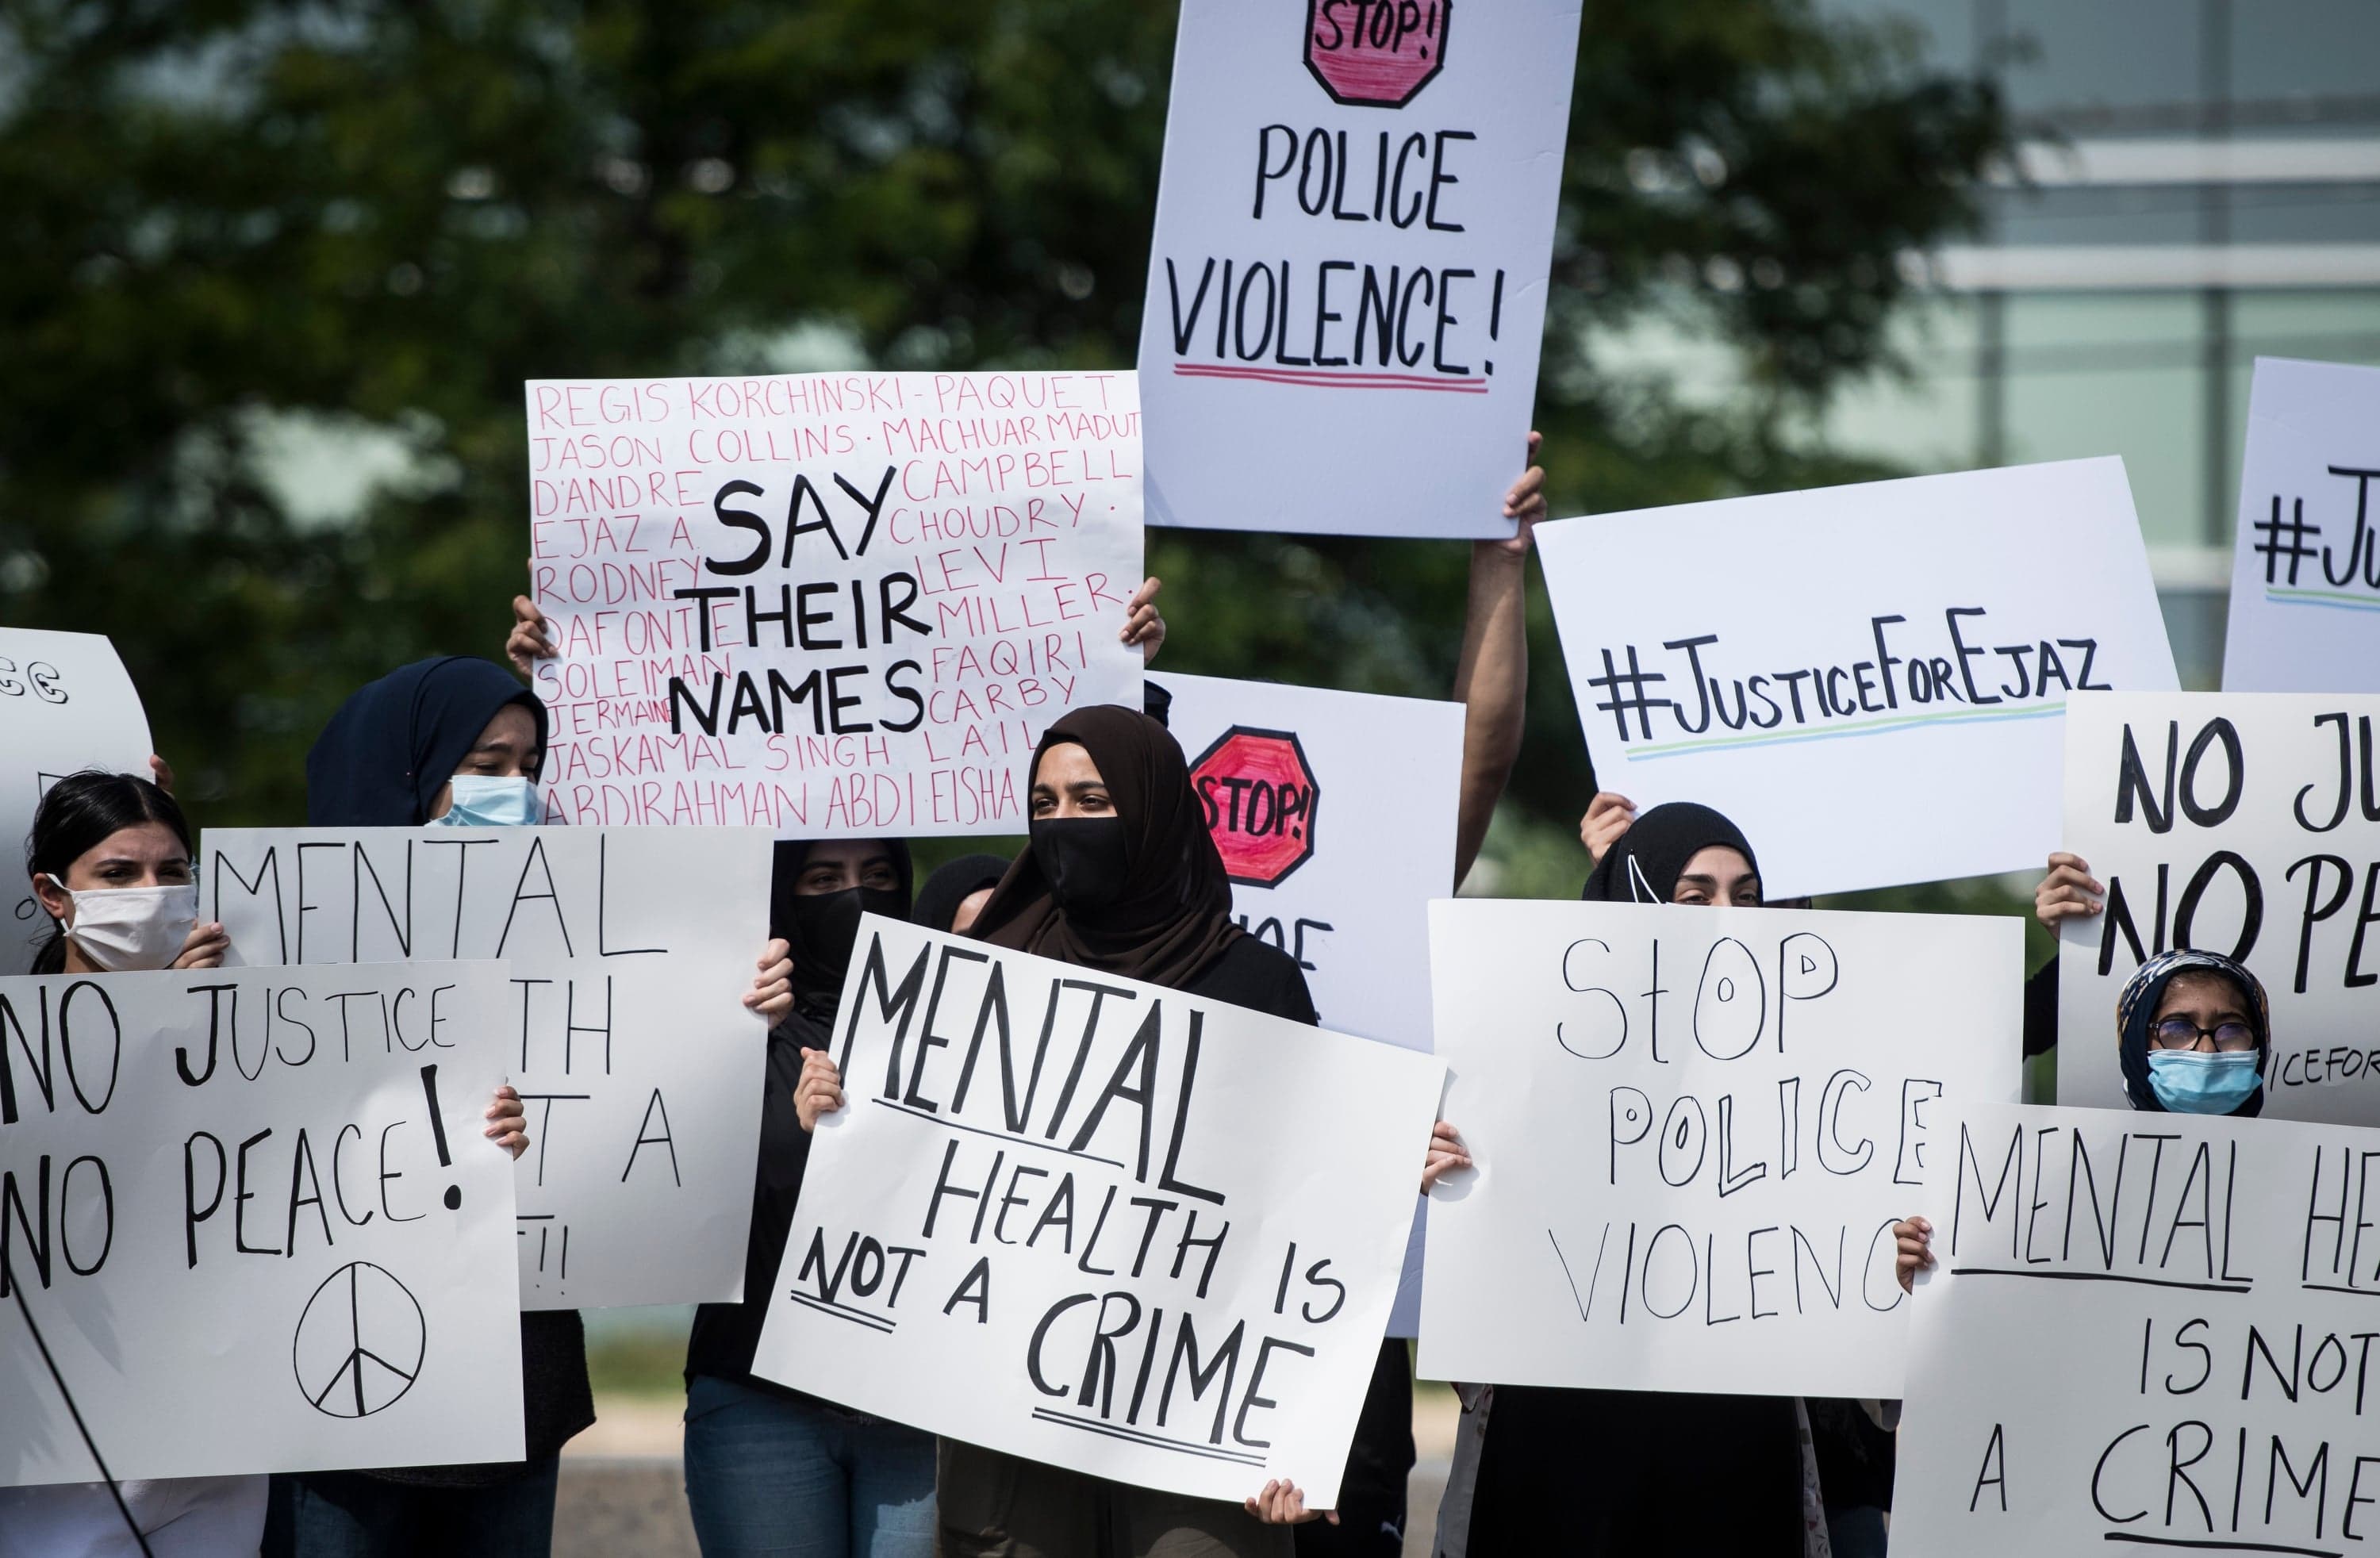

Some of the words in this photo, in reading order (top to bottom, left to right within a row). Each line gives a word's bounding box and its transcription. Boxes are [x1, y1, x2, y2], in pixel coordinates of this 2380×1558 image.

[1315, 0, 1437, 59] STOP!
[1253, 124, 1476, 232] POLICE
[1166, 256, 1504, 376] VIOLENCE!
[533, 435, 662, 471] JASON
[883, 416, 1040, 455] MACHUAR
[1047, 412, 1142, 441] MADUT
[537, 384, 670, 429] REGIS
[534, 515, 648, 558] EJAZ
[890, 493, 1084, 544] CHOUDRY
[535, 470, 704, 516] D'ANDRE
[903, 450, 1132, 501] CAMPBELL
[704, 465, 896, 575] SAY
[538, 555, 700, 604] RODNEY
[916, 538, 1068, 595] LEVI
[674, 572, 934, 652] THEIR
[538, 653, 731, 703] SOLEIMAN
[933, 631, 1085, 682] FAQIRI
[547, 696, 673, 739] JERMAINE
[929, 676, 1074, 724] CARBY
[669, 659, 925, 736] NAMES
[546, 733, 746, 784] JASKAMAL
[766, 735, 889, 771] SINGH
[924, 721, 1036, 762] LAIL
[546, 780, 806, 828] ABDIRAHMAN
[826, 773, 914, 829] ABDI
[931, 766, 1019, 824] EISHA
[2115, 717, 2244, 834] NO
[1197, 776, 1309, 839] STOP!
[215, 833, 668, 965] MENTAL
[2098, 850, 2263, 976] NO
[0, 980, 121, 1125] NO
[175, 984, 456, 1087] JUSTICE
[840, 931, 1226, 1205] MENTAL
[622, 1088, 681, 1187] A
[1610, 1069, 1942, 1198] POLICE
[0, 1155, 113, 1298] NO
[921, 1139, 1230, 1300] HEALTH
[1274, 1241, 1346, 1324] IS
[1952, 1121, 2254, 1282] MENTAL
[798, 1226, 927, 1308] NOT
[943, 1257, 991, 1324] A
[1026, 1291, 1315, 1449] CRIME
[2141, 1318, 2212, 1395] IS
[2241, 1324, 2380, 1415] NOT
[1970, 1424, 2007, 1511] A
[2091, 1421, 2380, 1541] CRIME
